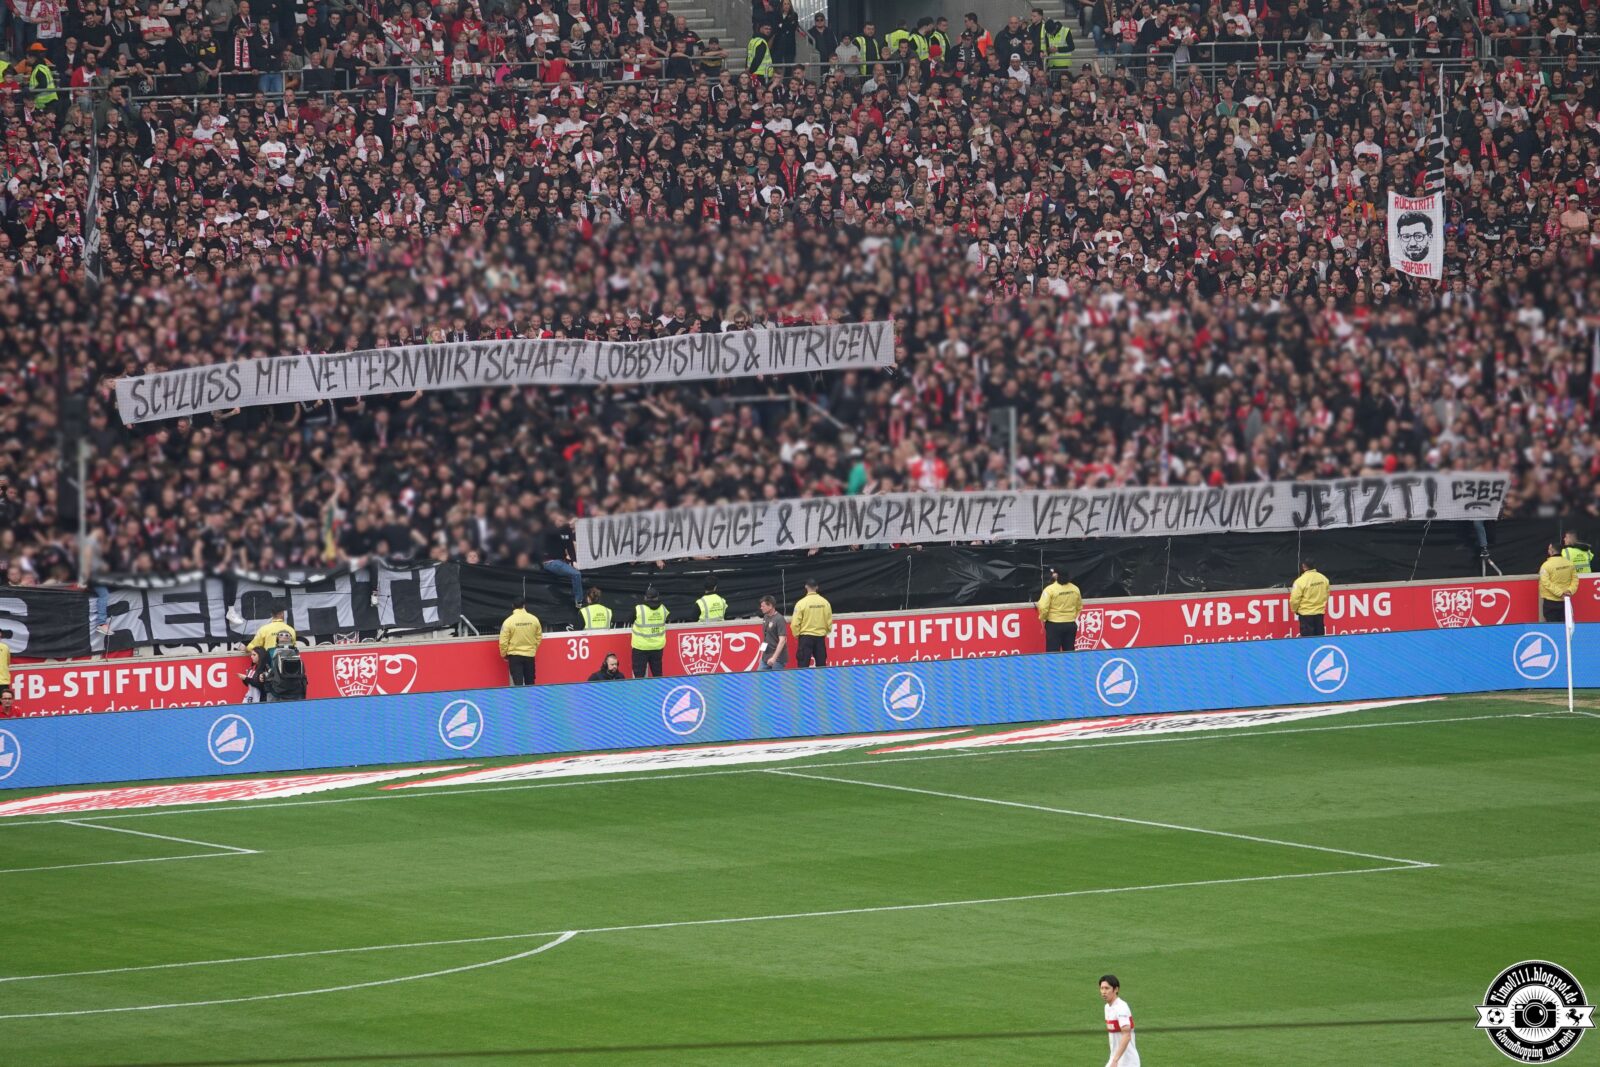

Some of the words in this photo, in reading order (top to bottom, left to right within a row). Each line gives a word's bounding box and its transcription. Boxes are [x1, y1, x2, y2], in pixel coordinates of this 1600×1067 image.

[130, 363, 242, 420] SCHLUSS
[256, 358, 299, 396] MIT
[593, 333, 740, 382] LOBBYISMUS
[743, 330, 760, 373] &
[769, 324, 883, 369] INTRIGEN
[776, 502, 795, 546] &
[800, 494, 1016, 543] TRANSPARENTE
[1292, 477, 1438, 528] JETZT!
[1181, 592, 1391, 627] VfB-STIUNG
[826, 613, 1020, 648] fB-STIFTUNG
[567, 638, 590, 660] 36
[12, 662, 228, 700] fB-STIFTUNG
